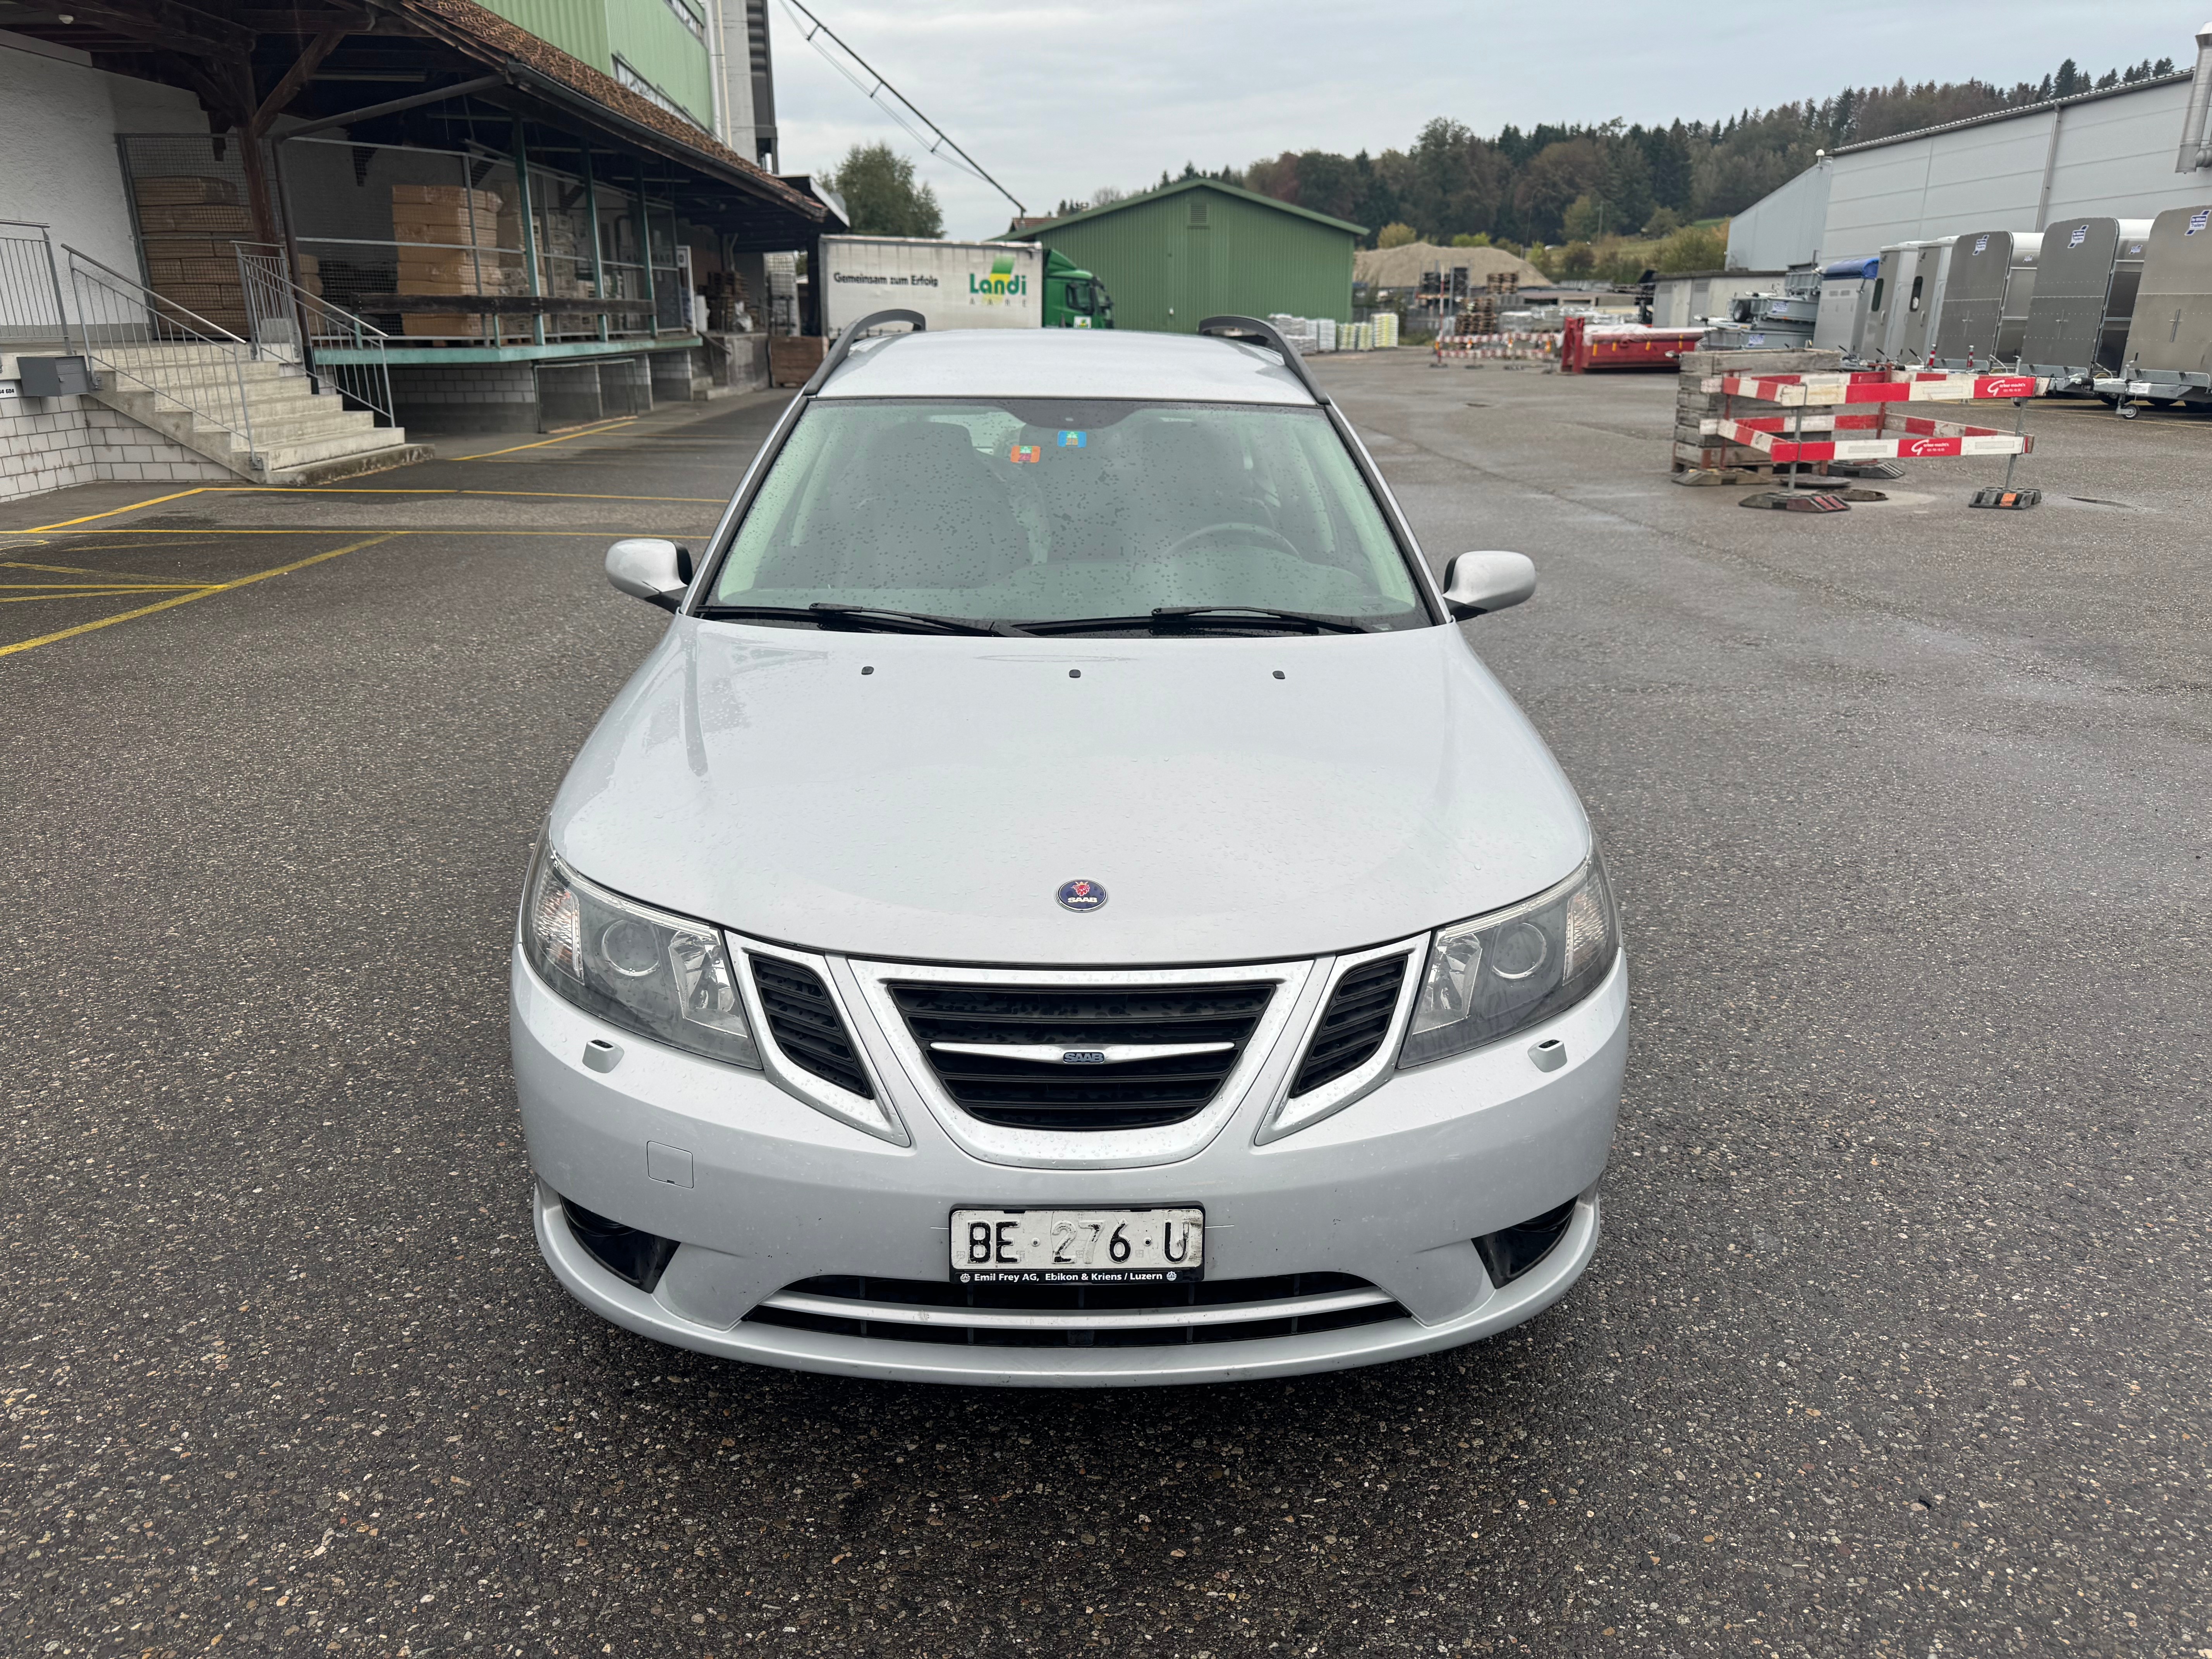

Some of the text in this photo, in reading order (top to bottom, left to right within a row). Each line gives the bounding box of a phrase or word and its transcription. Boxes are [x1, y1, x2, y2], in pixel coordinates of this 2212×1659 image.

[833, 272, 938, 287] Gemeinsam zum Erfolg
[969, 273, 1026, 295] Landi
[1064, 1053, 1103, 1062] SAAB
[968, 1219, 1189, 1264] BE 276 U
[999, 1273, 1019, 1282] Frey
[1022, 1273, 1039, 1281] AG,
